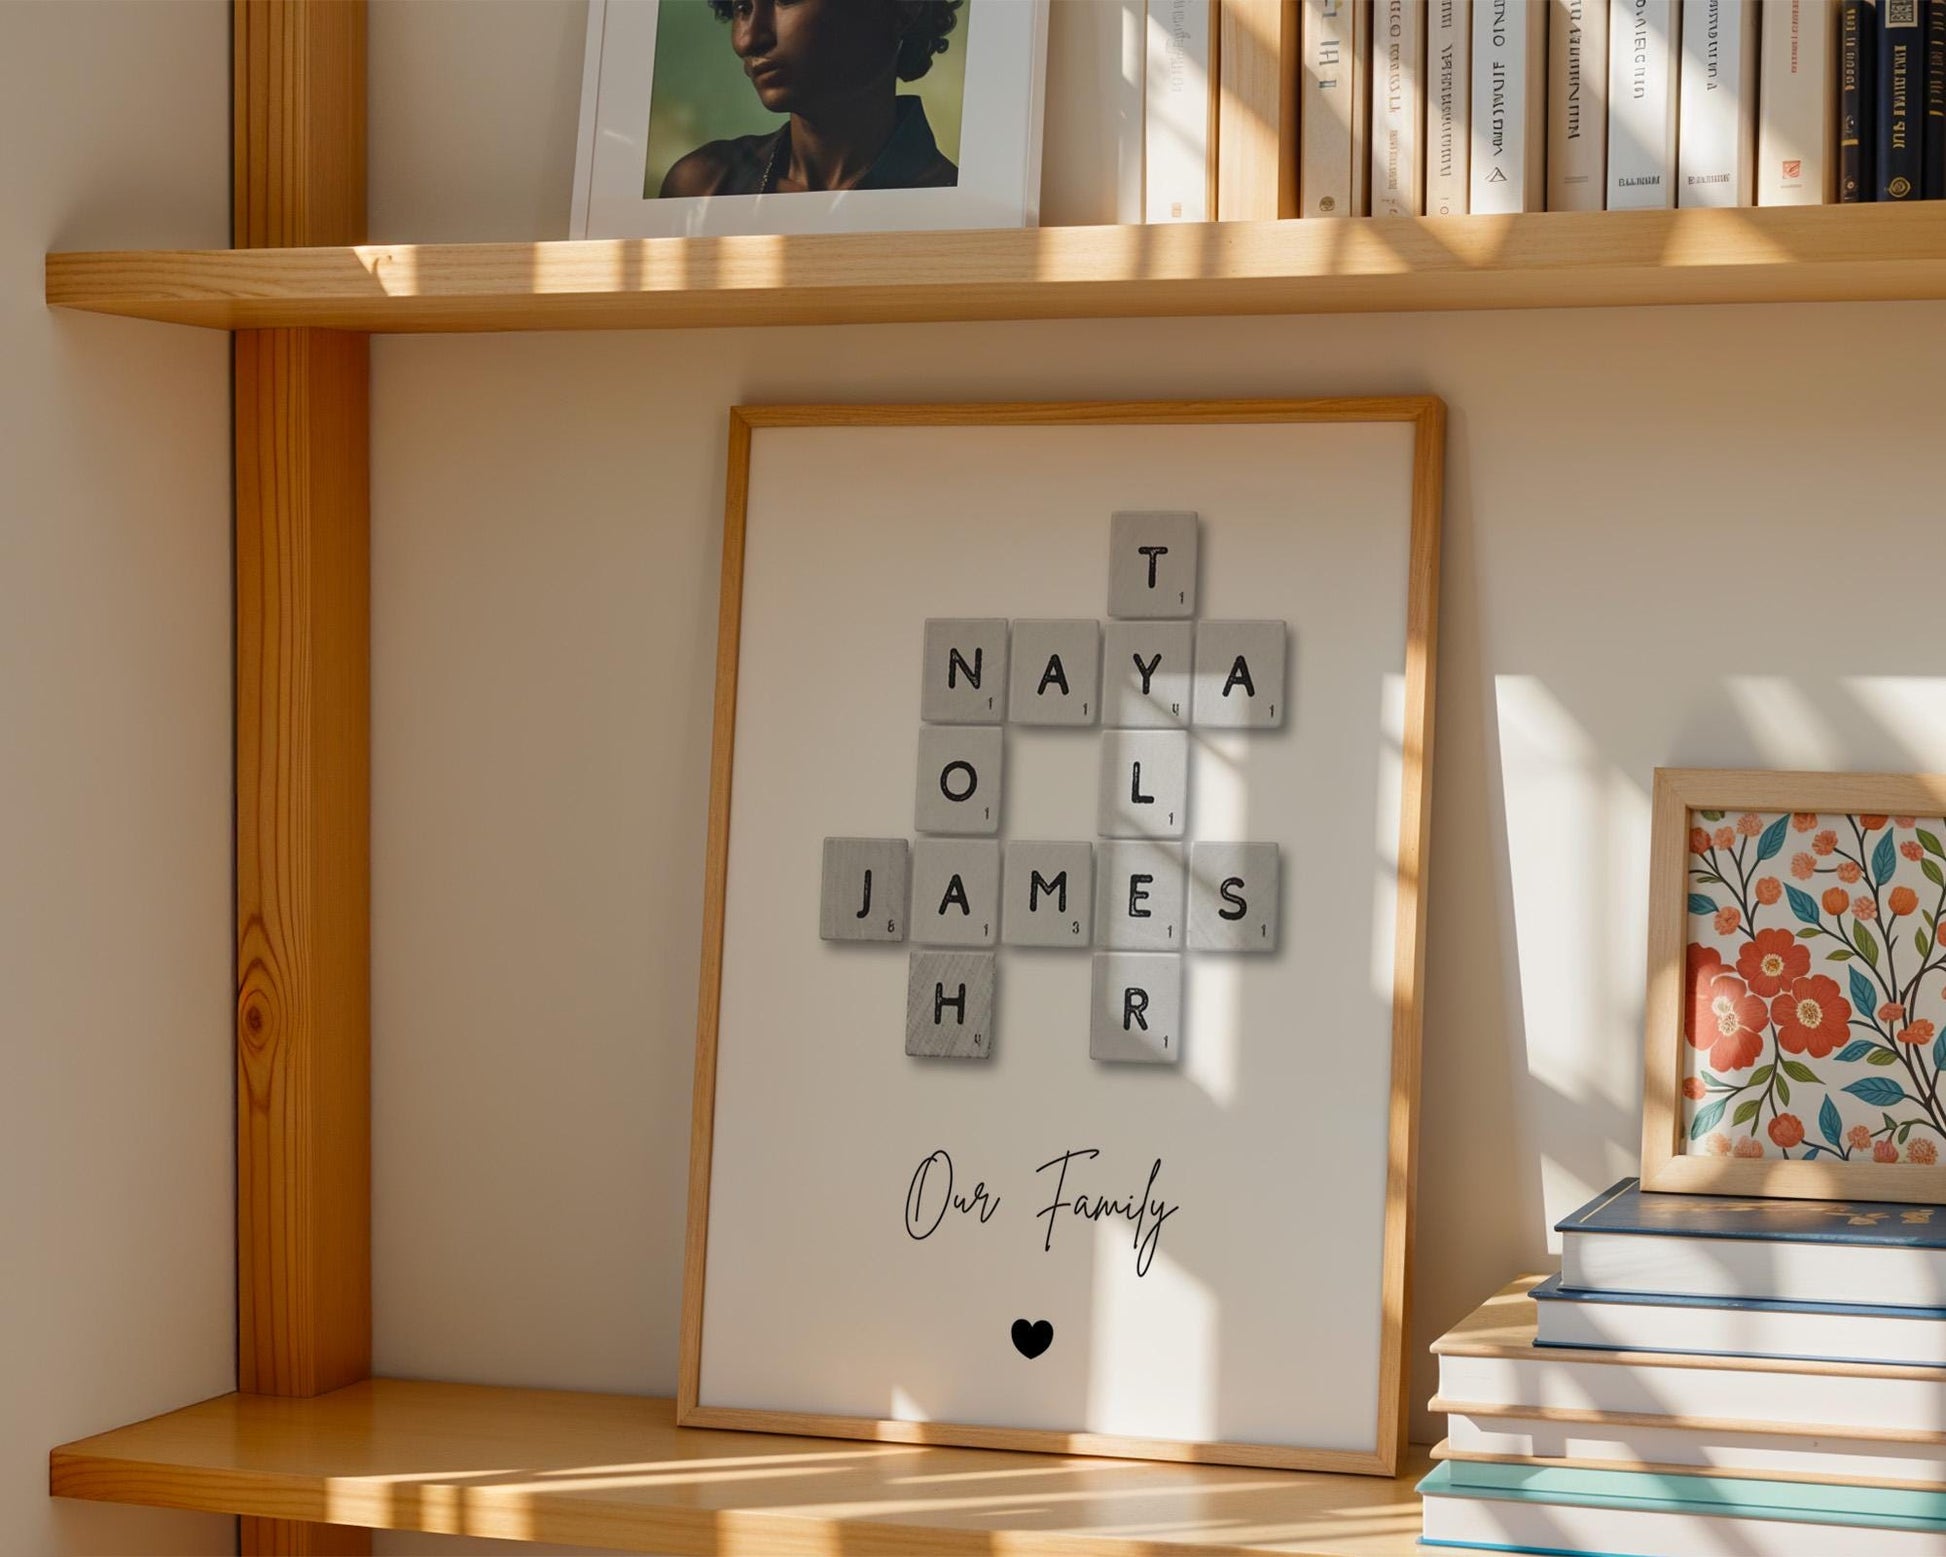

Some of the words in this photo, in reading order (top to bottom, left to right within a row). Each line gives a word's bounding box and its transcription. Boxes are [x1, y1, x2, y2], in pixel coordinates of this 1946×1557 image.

[948, 647, 1256, 698] NAYA
[856, 869, 1248, 921] JAMES
[905, 1149, 1001, 1240] Our
[1036, 1148, 1180, 1277] Family
